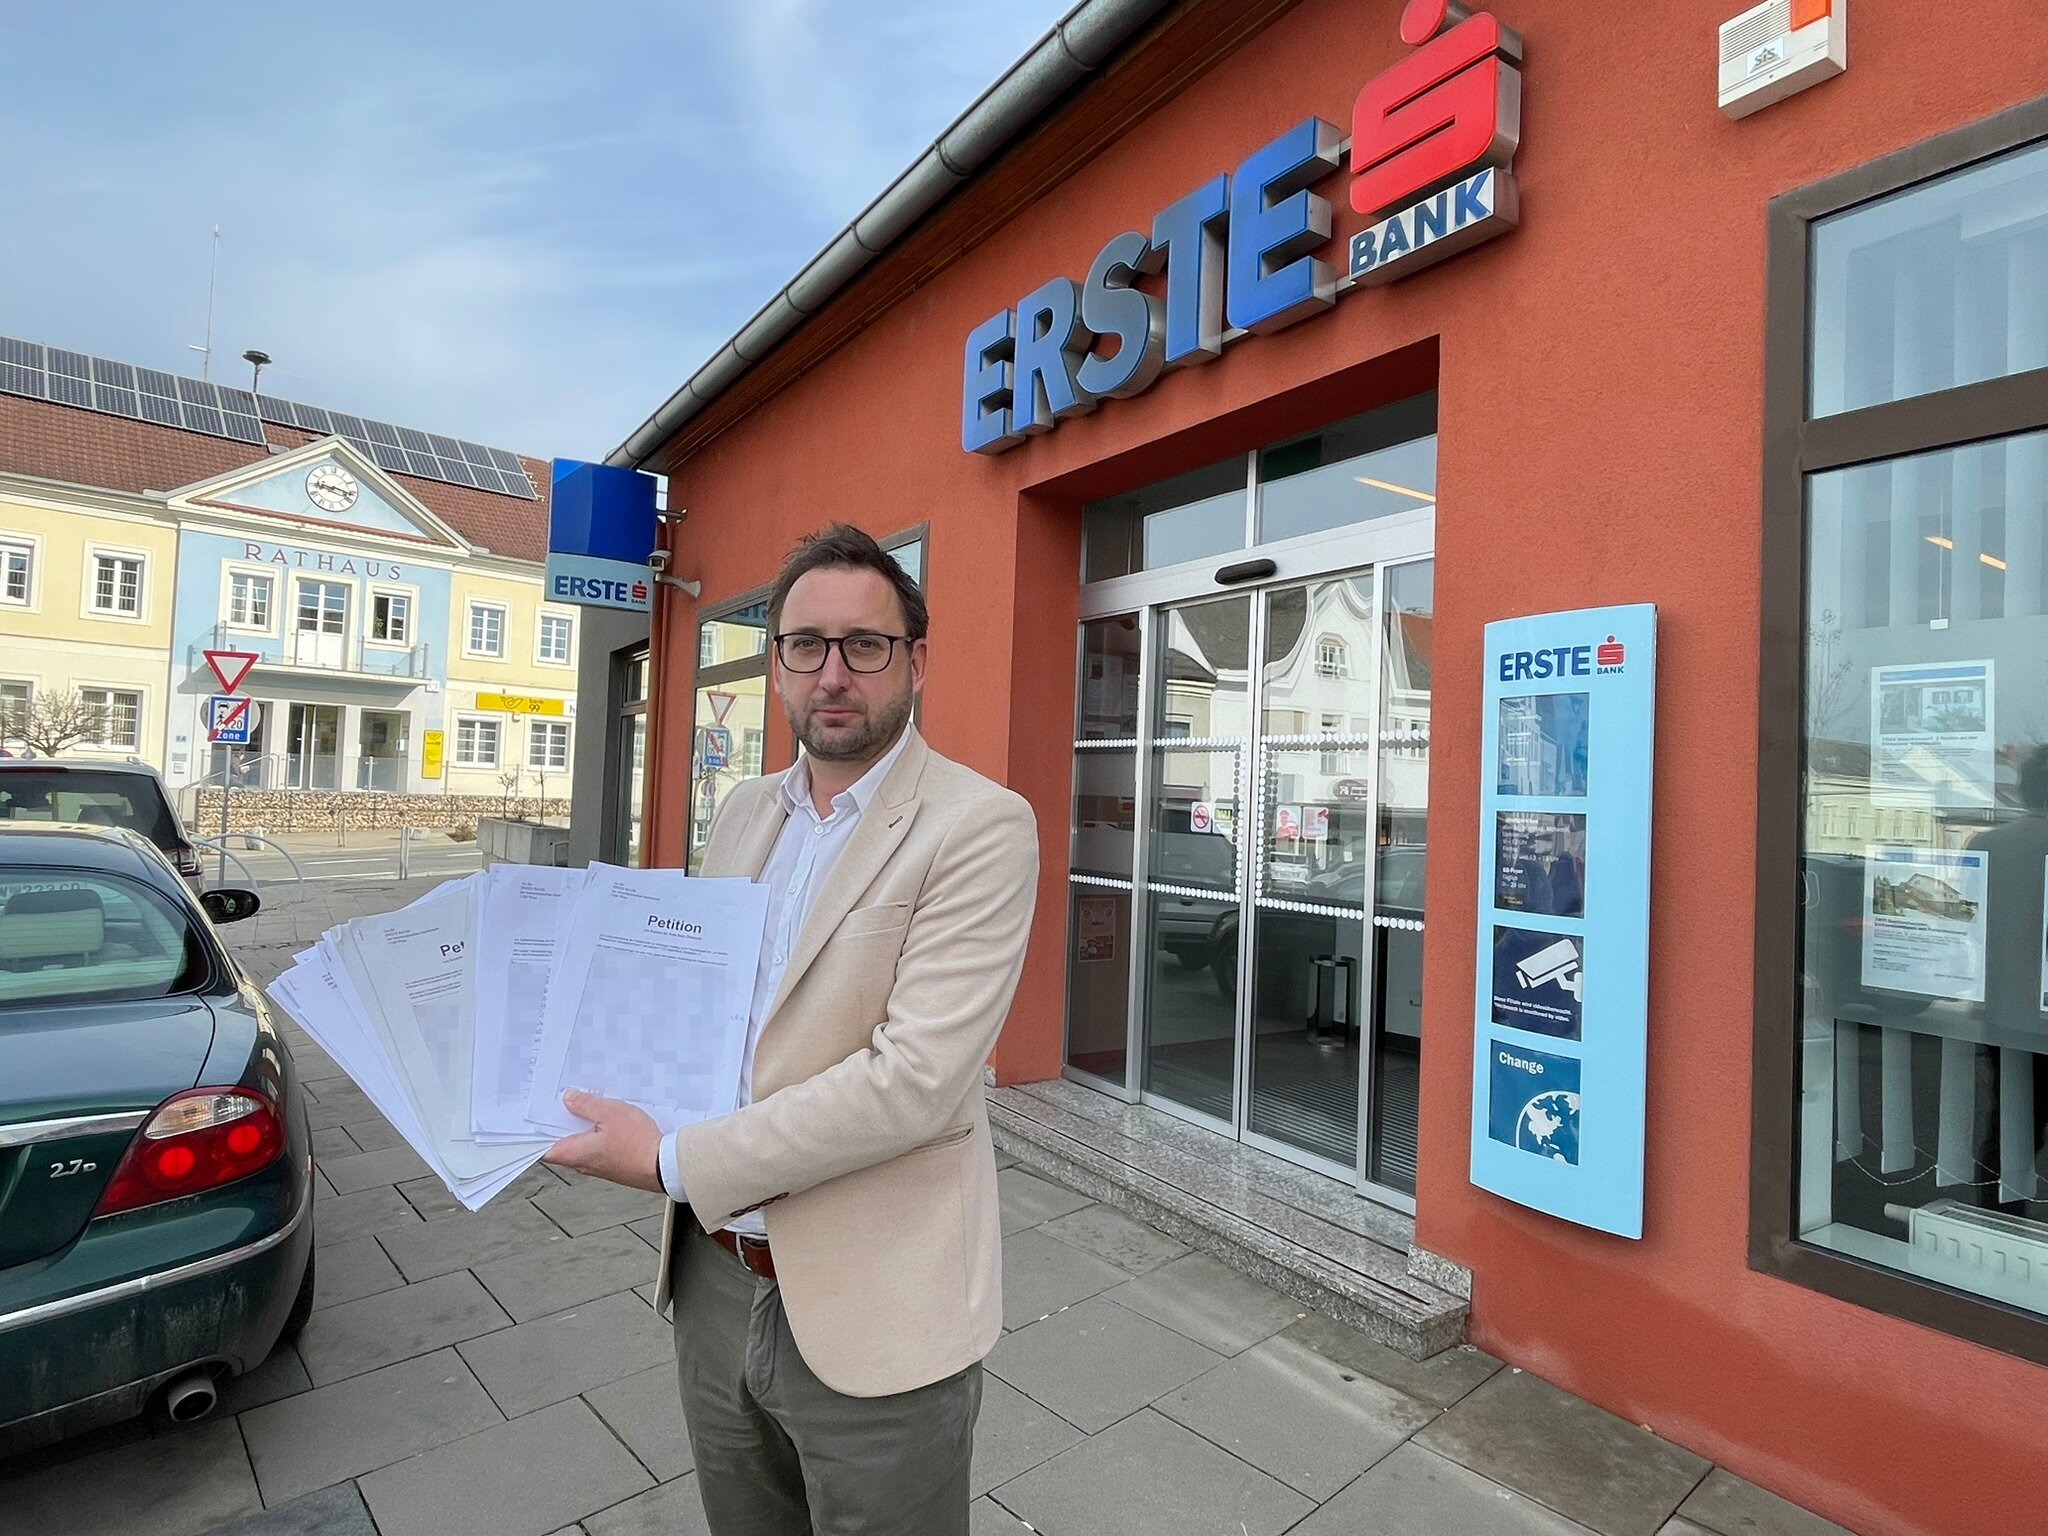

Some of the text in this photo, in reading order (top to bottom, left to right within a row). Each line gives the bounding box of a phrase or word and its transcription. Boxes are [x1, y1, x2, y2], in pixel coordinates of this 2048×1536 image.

[1350, 168, 1494, 276] BANK
[962, 116, 1338, 455] ERSTE
[245, 543, 401, 580] RATHAUS
[554, 575, 628, 602] ERSTE
[1500, 645, 1591, 682] ERSTE
[1597, 666, 1624, 675] BANK
[529, 704, 540, 712] 99
[216, 730, 241, 740] Zone
[231, 720, 243, 729] 20
[647, 915, 702, 934] Petition
[1499, 1051, 1544, 1075] Change
